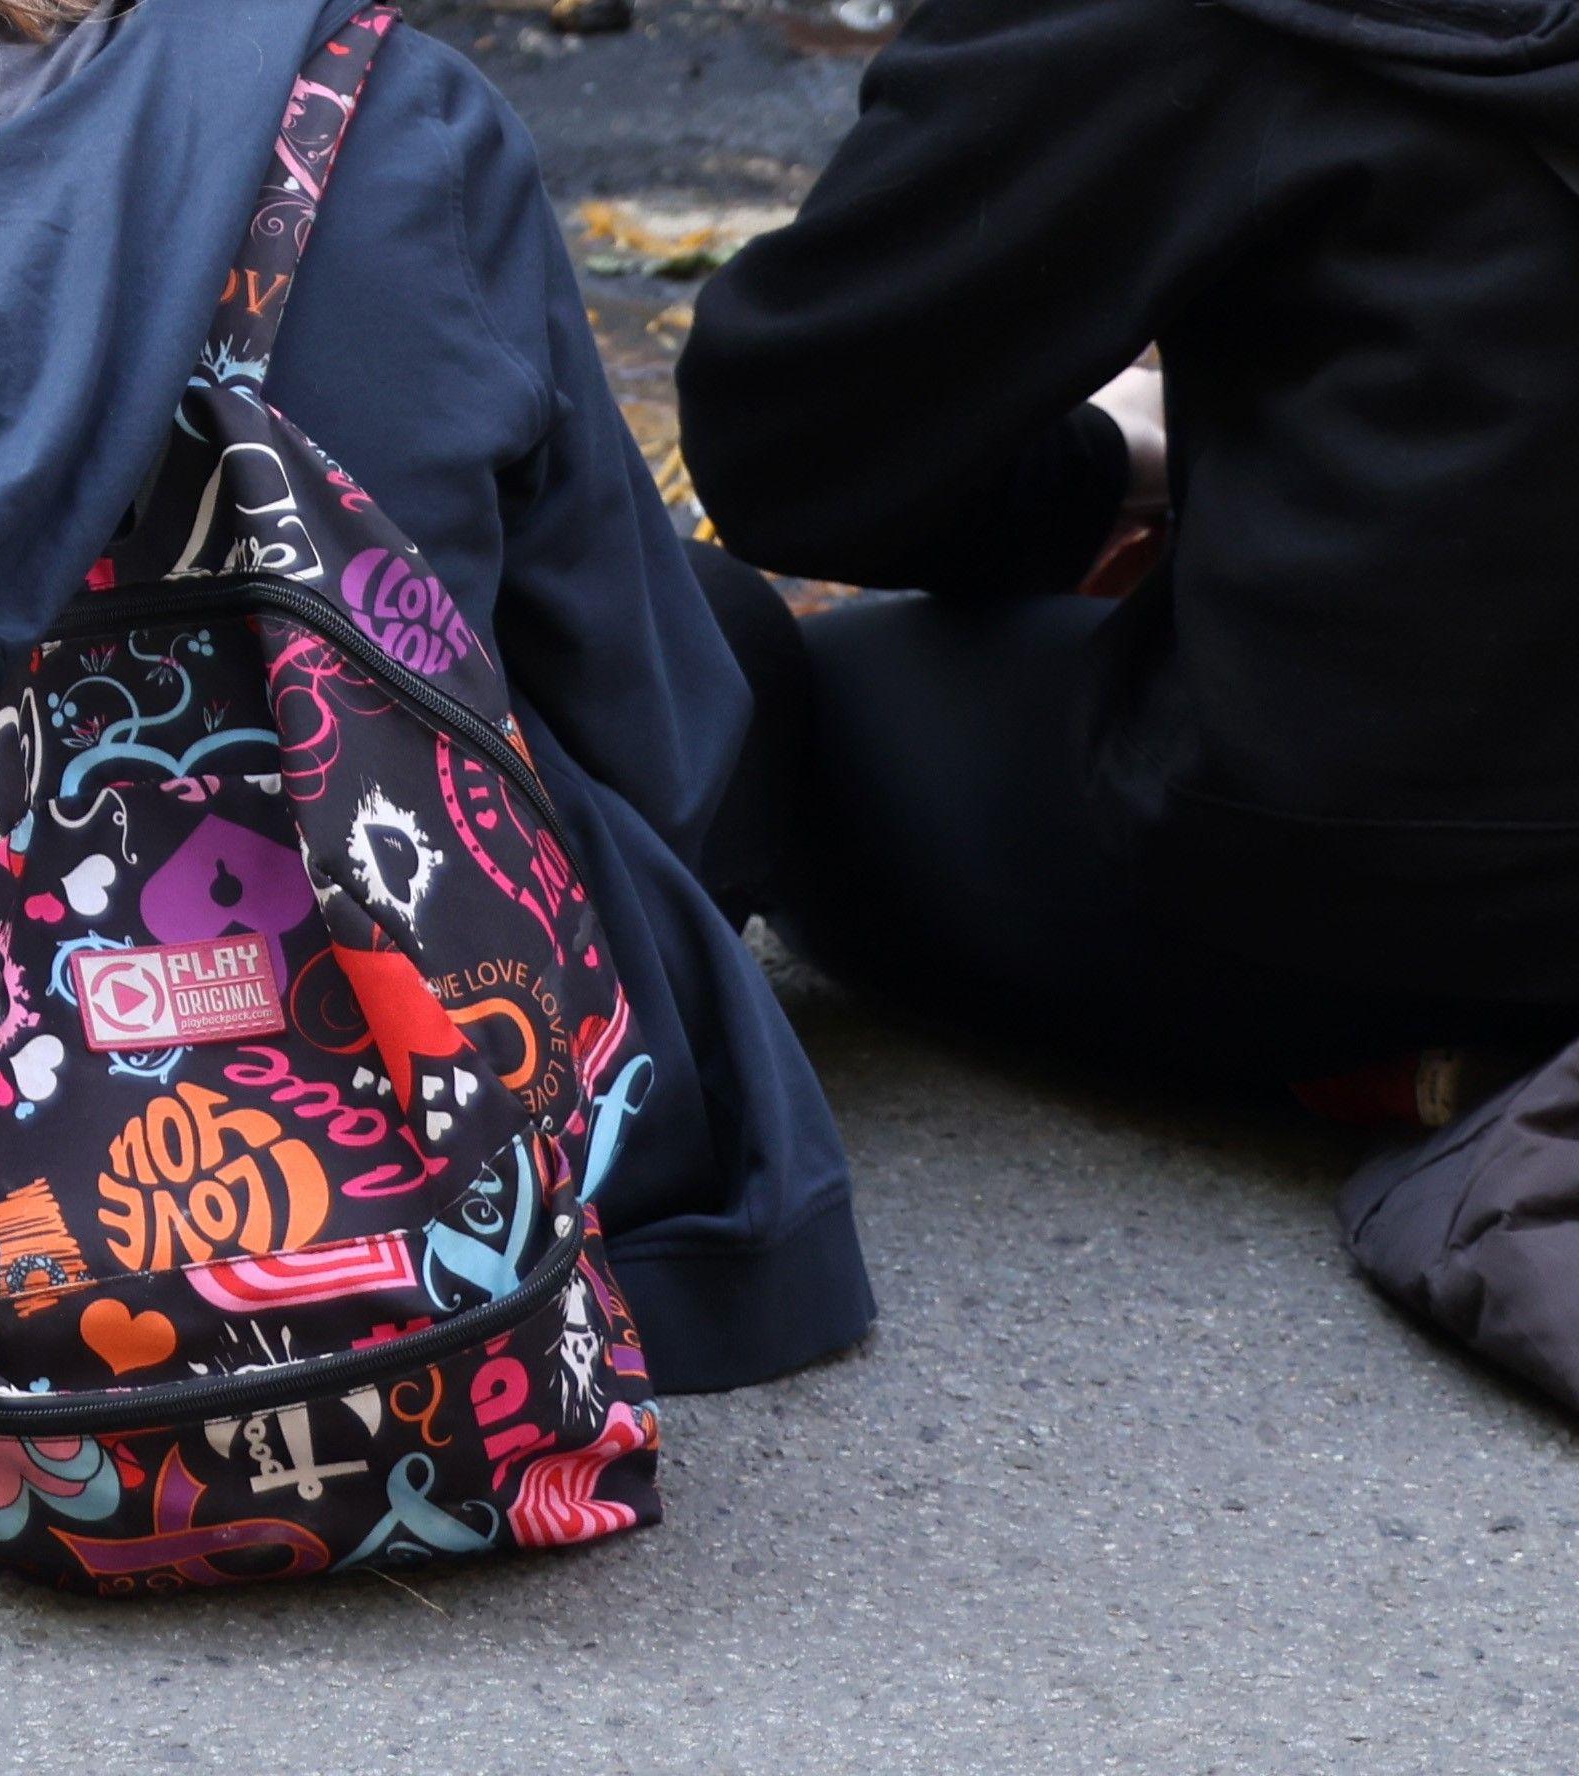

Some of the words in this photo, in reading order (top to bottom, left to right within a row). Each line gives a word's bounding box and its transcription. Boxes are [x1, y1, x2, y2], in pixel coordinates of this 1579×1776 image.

[166, 943, 259, 984] PLAY
[464, 958, 529, 992] LOVE
[175, 980, 271, 1017] ORIGINAL
[531, 976, 567, 1055] LOVE
[520, 1058, 565, 1114] LOVE
